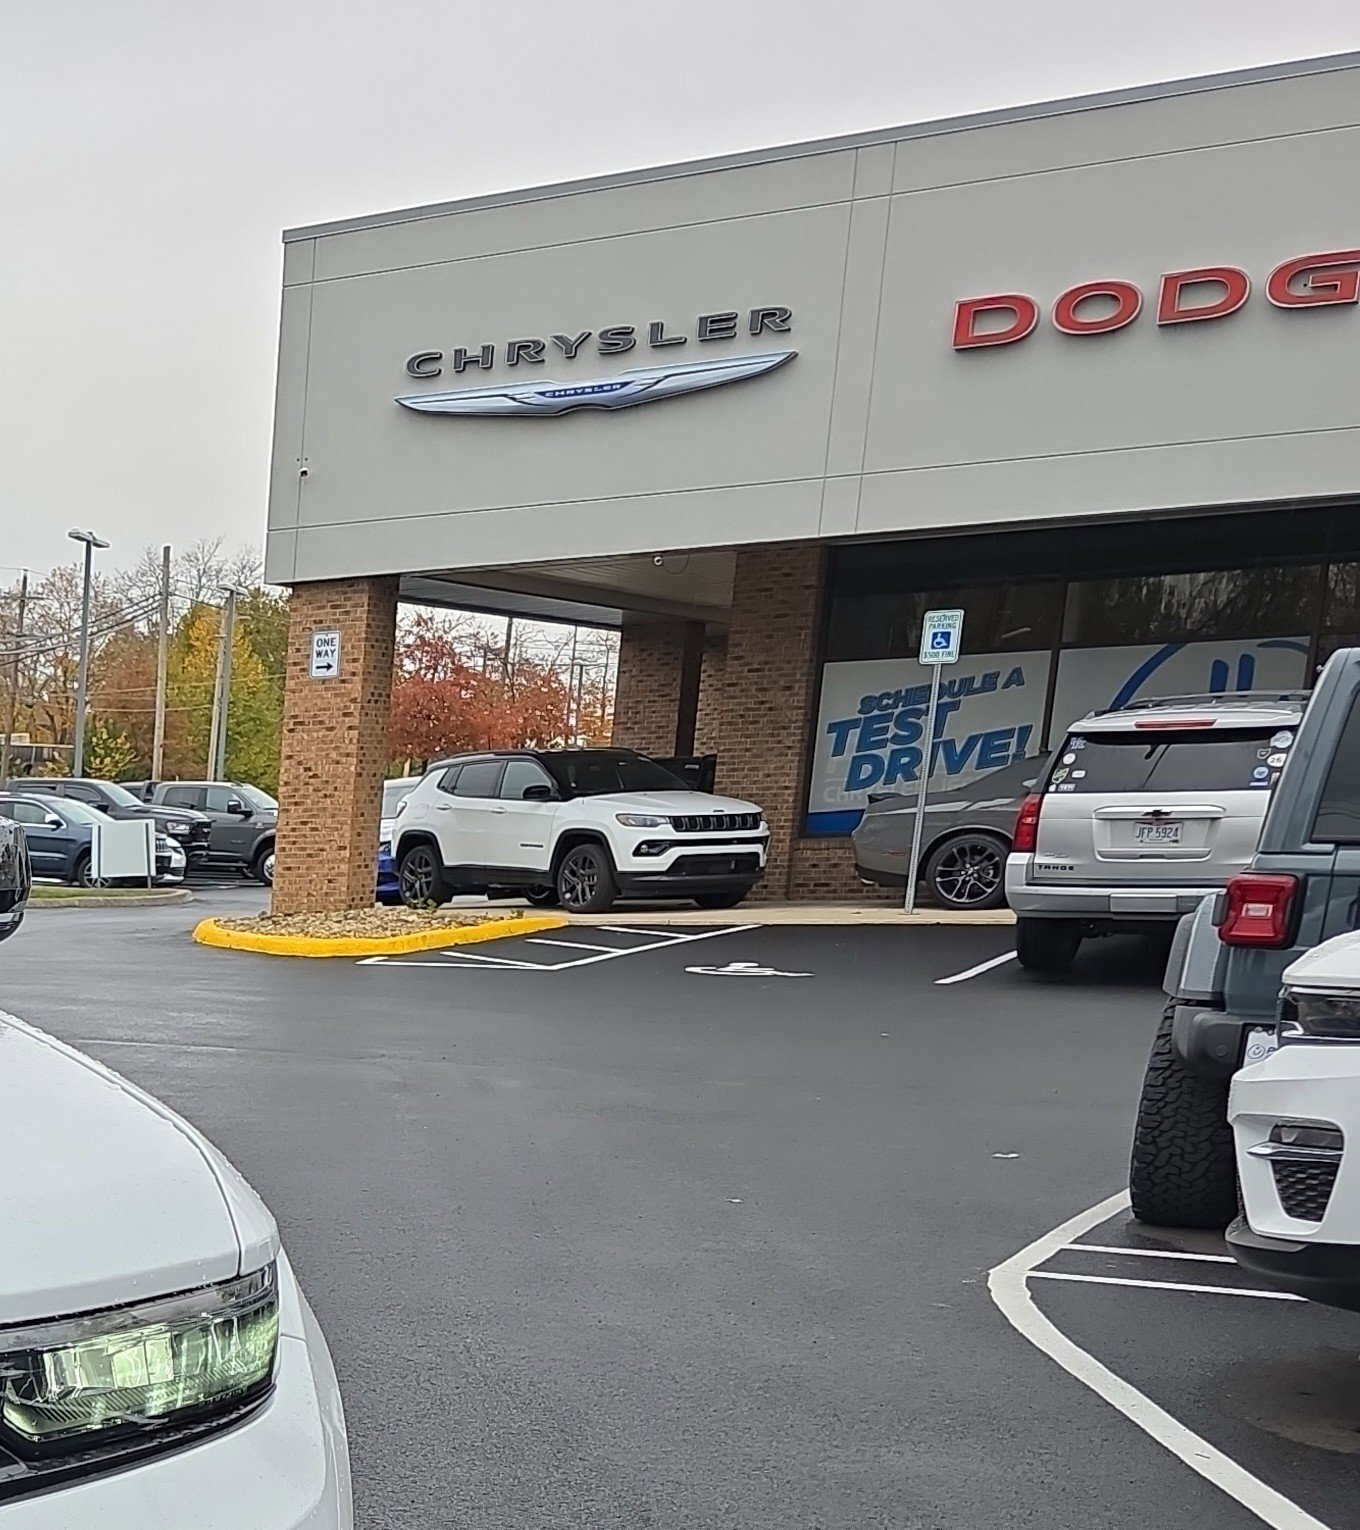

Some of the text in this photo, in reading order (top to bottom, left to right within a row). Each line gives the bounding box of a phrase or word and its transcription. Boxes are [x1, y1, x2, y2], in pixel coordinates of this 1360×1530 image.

[405, 306, 793, 378] CHRYSLER
[315, 637, 337, 648] ONE
[315, 648, 337, 659] WAY
[1001, 666, 1026, 690] A
[826, 699, 962, 757] TEST
[843, 724, 1034, 792] DRIVE!
